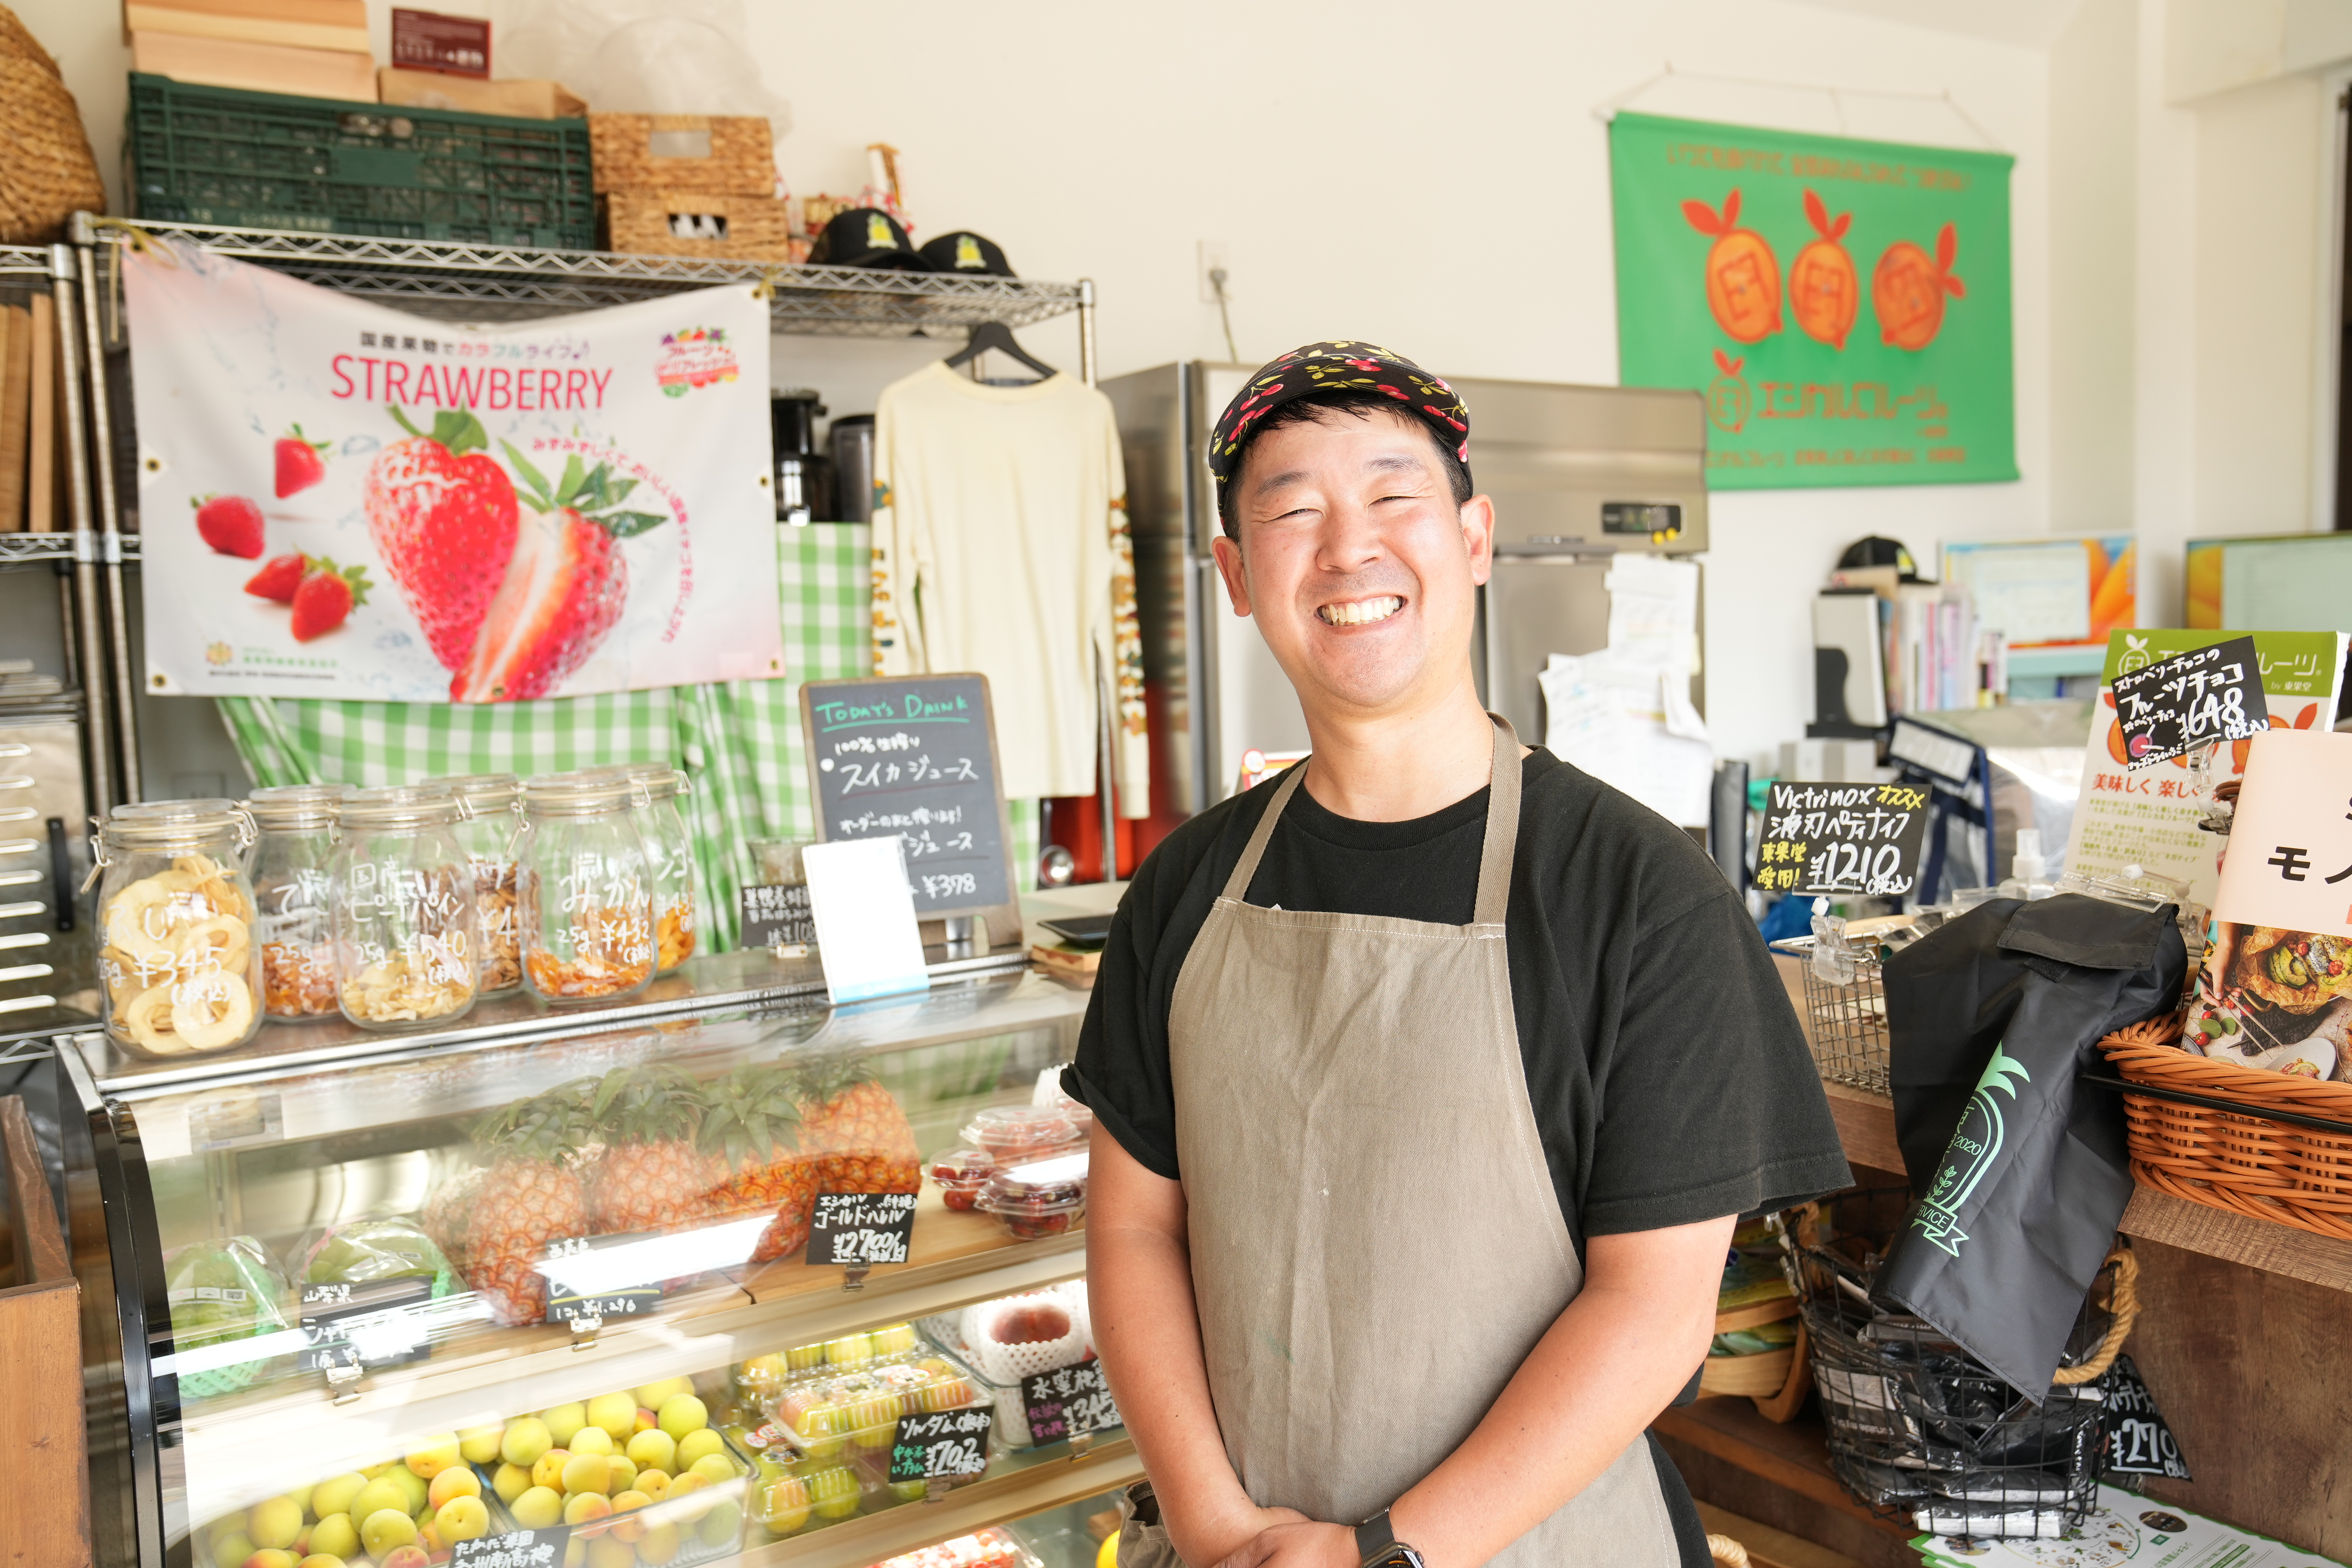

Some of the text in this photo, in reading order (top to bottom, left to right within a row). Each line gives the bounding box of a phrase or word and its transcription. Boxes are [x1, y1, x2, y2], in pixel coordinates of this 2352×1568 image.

[331, 353, 613, 411] STRAWBERRY
[2115, 648, 2220, 693] ストロベリーチョコの
[2271, 680, 2312, 692] by 東果堂
[2119, 663, 2244, 720] フルーツチョコ
[2176, 687, 2245, 741] ¥648
[1876, 785, 1926, 811] オススメ
[2092, 773, 2151, 795] 美味しく
[1768, 807, 1910, 841] 波刃ペティナイフ
[1762, 841, 1807, 863] 東果堂
[1808, 841, 1901, 885] ¥1210
[559, 874, 651, 914] みかん
[921, 872, 977, 899] ¥378
[350, 891, 465, 923] ピーチパイン
[354, 929, 467, 970] 25g ¥540
[556, 926, 592, 953] 25g
[600, 917, 650, 952] ¥432
[133, 946, 226, 989] ¥345
[270, 941, 314, 973] 25g
[1954, 1136, 1982, 1155] 2020
[820, 1193, 867, 1208] エシカル
[303, 1284, 354, 1304] 山梨県
[924, 1437, 981, 1474] ¥702
[2110, 1418, 2178, 1467] ¥270
